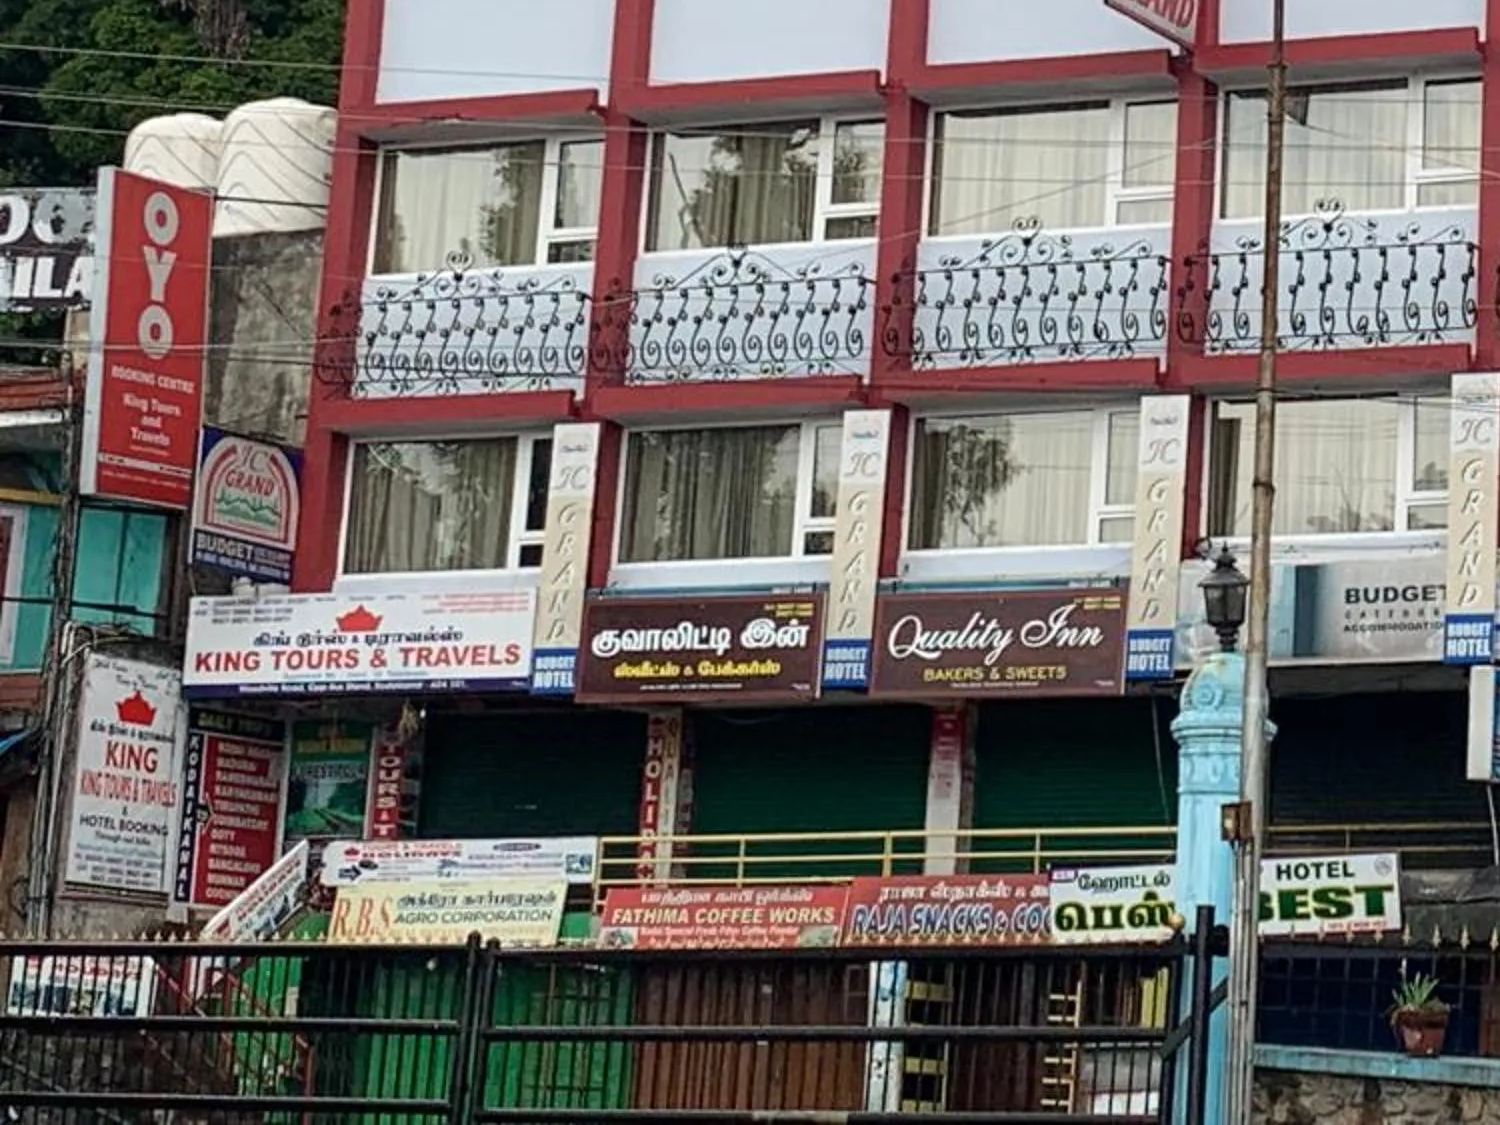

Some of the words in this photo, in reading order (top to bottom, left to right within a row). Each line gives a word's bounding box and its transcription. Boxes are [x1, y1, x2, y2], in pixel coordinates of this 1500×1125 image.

[138, 191, 180, 360] OYO
[224, 470, 275, 496] GRAND
[195, 533, 254, 560] BUDGET
[1344, 584, 1447, 604] BUDGET
[740, 617, 810, 649] இன்
[888, 611, 1014, 666] Quality
[1020, 602, 1104, 649] Inn
[1343, 621, 1443, 633] ACCOMMODATIO
[1447, 638, 1491, 656] HOTEL
[195, 651, 261, 672] KING
[271, 649, 360, 670] TOURS
[369, 648, 388, 668] &
[399, 644, 521, 667] TRAVELS
[1128, 654, 1170, 671] HOTEL
[533, 671, 574, 688] HOTEL
[825, 662, 867, 680] HOTEL
[923, 667, 985, 682] BAKERS
[990, 668, 1000, 680] &
[1005, 666, 1067, 681] SWEETS
[105, 740, 159, 773] KING
[80, 814, 116, 830] HOTEL
[1276, 861, 1355, 881] HOTEL
[394, 912, 439, 924] AGRO
[441, 910, 553, 924] CORPORATION
[611, 908, 689, 924] FATHIMA
[695, 907, 764, 924] COFFEE
[769, 906, 836, 923] WORKS
[851, 903, 907, 936] RAJA
[909, 902, 994, 936] SNACKS
